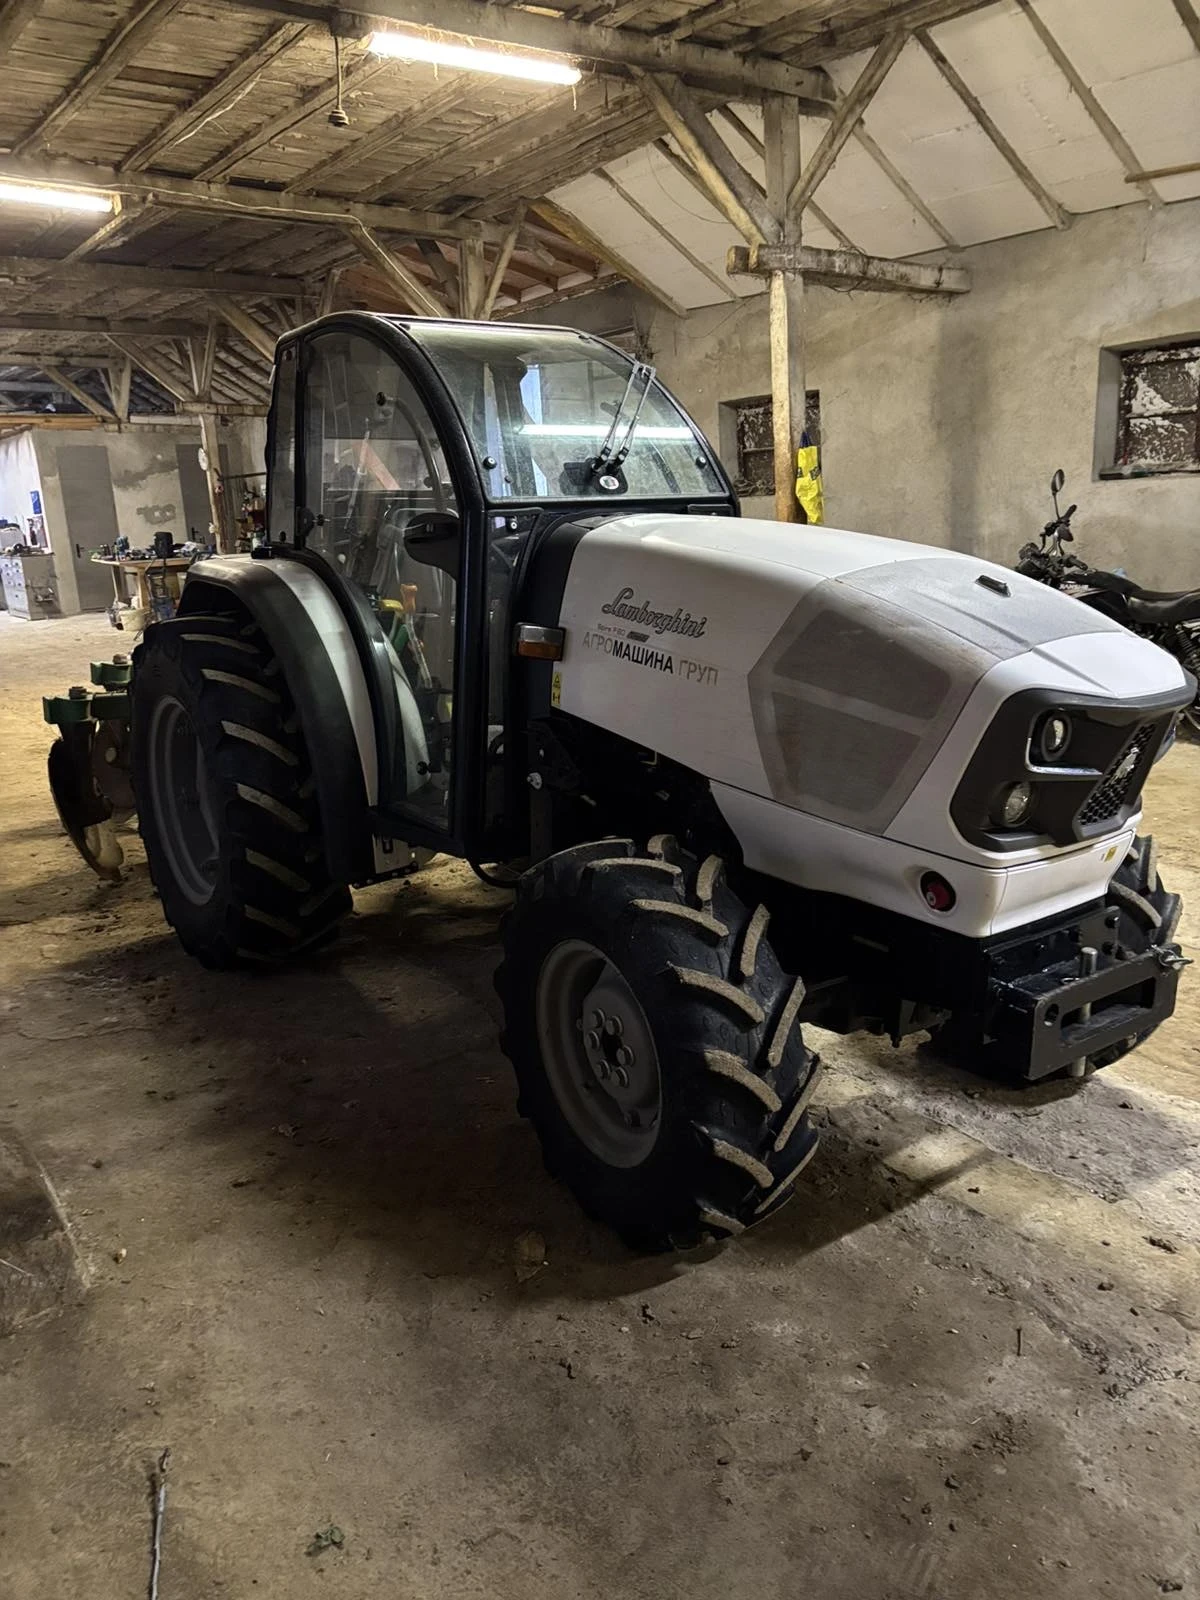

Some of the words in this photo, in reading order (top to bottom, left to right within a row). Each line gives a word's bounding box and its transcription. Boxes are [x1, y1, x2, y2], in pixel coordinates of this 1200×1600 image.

[601, 587, 708, 638] Lamborghini
[582, 631, 674, 674] АГРОМАШИНА
[678, 659, 719, 685] ГРУП
